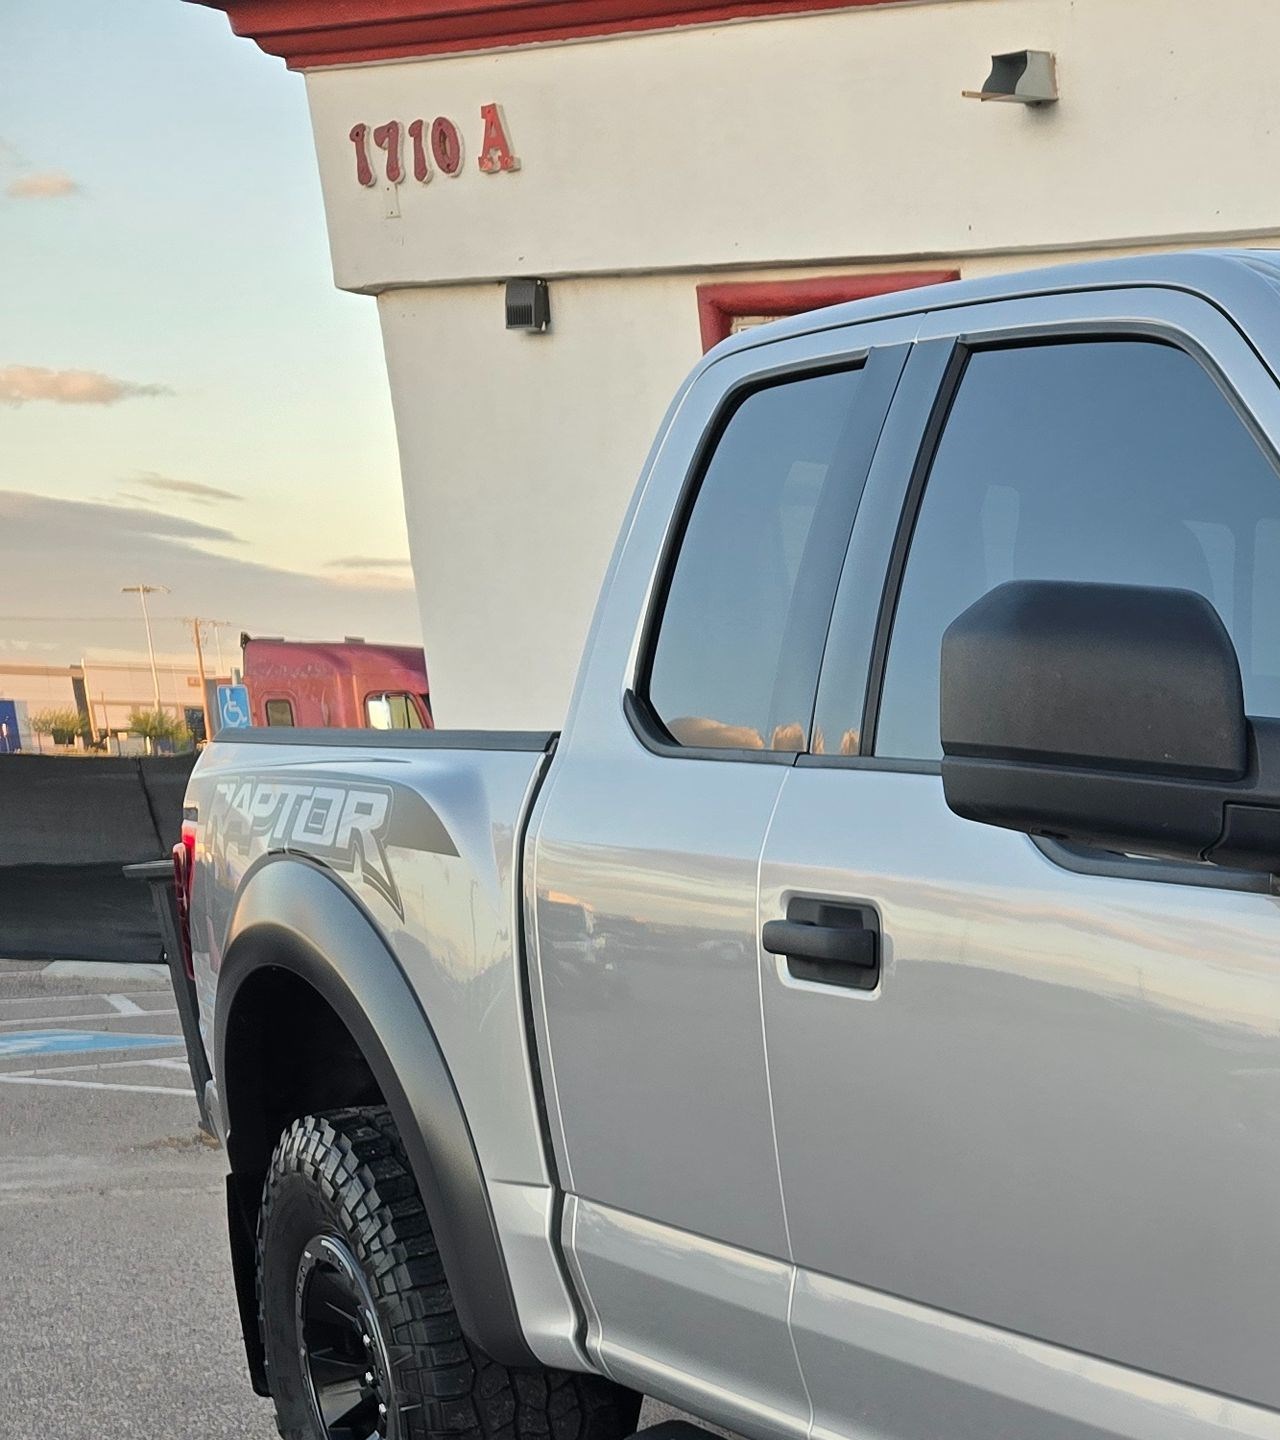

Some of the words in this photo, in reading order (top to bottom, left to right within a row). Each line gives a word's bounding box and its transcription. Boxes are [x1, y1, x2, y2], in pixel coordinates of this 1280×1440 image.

[350, 116, 461, 186] 1710
[478, 103, 515, 172] A
[208, 782, 392, 888] RAPTOR
